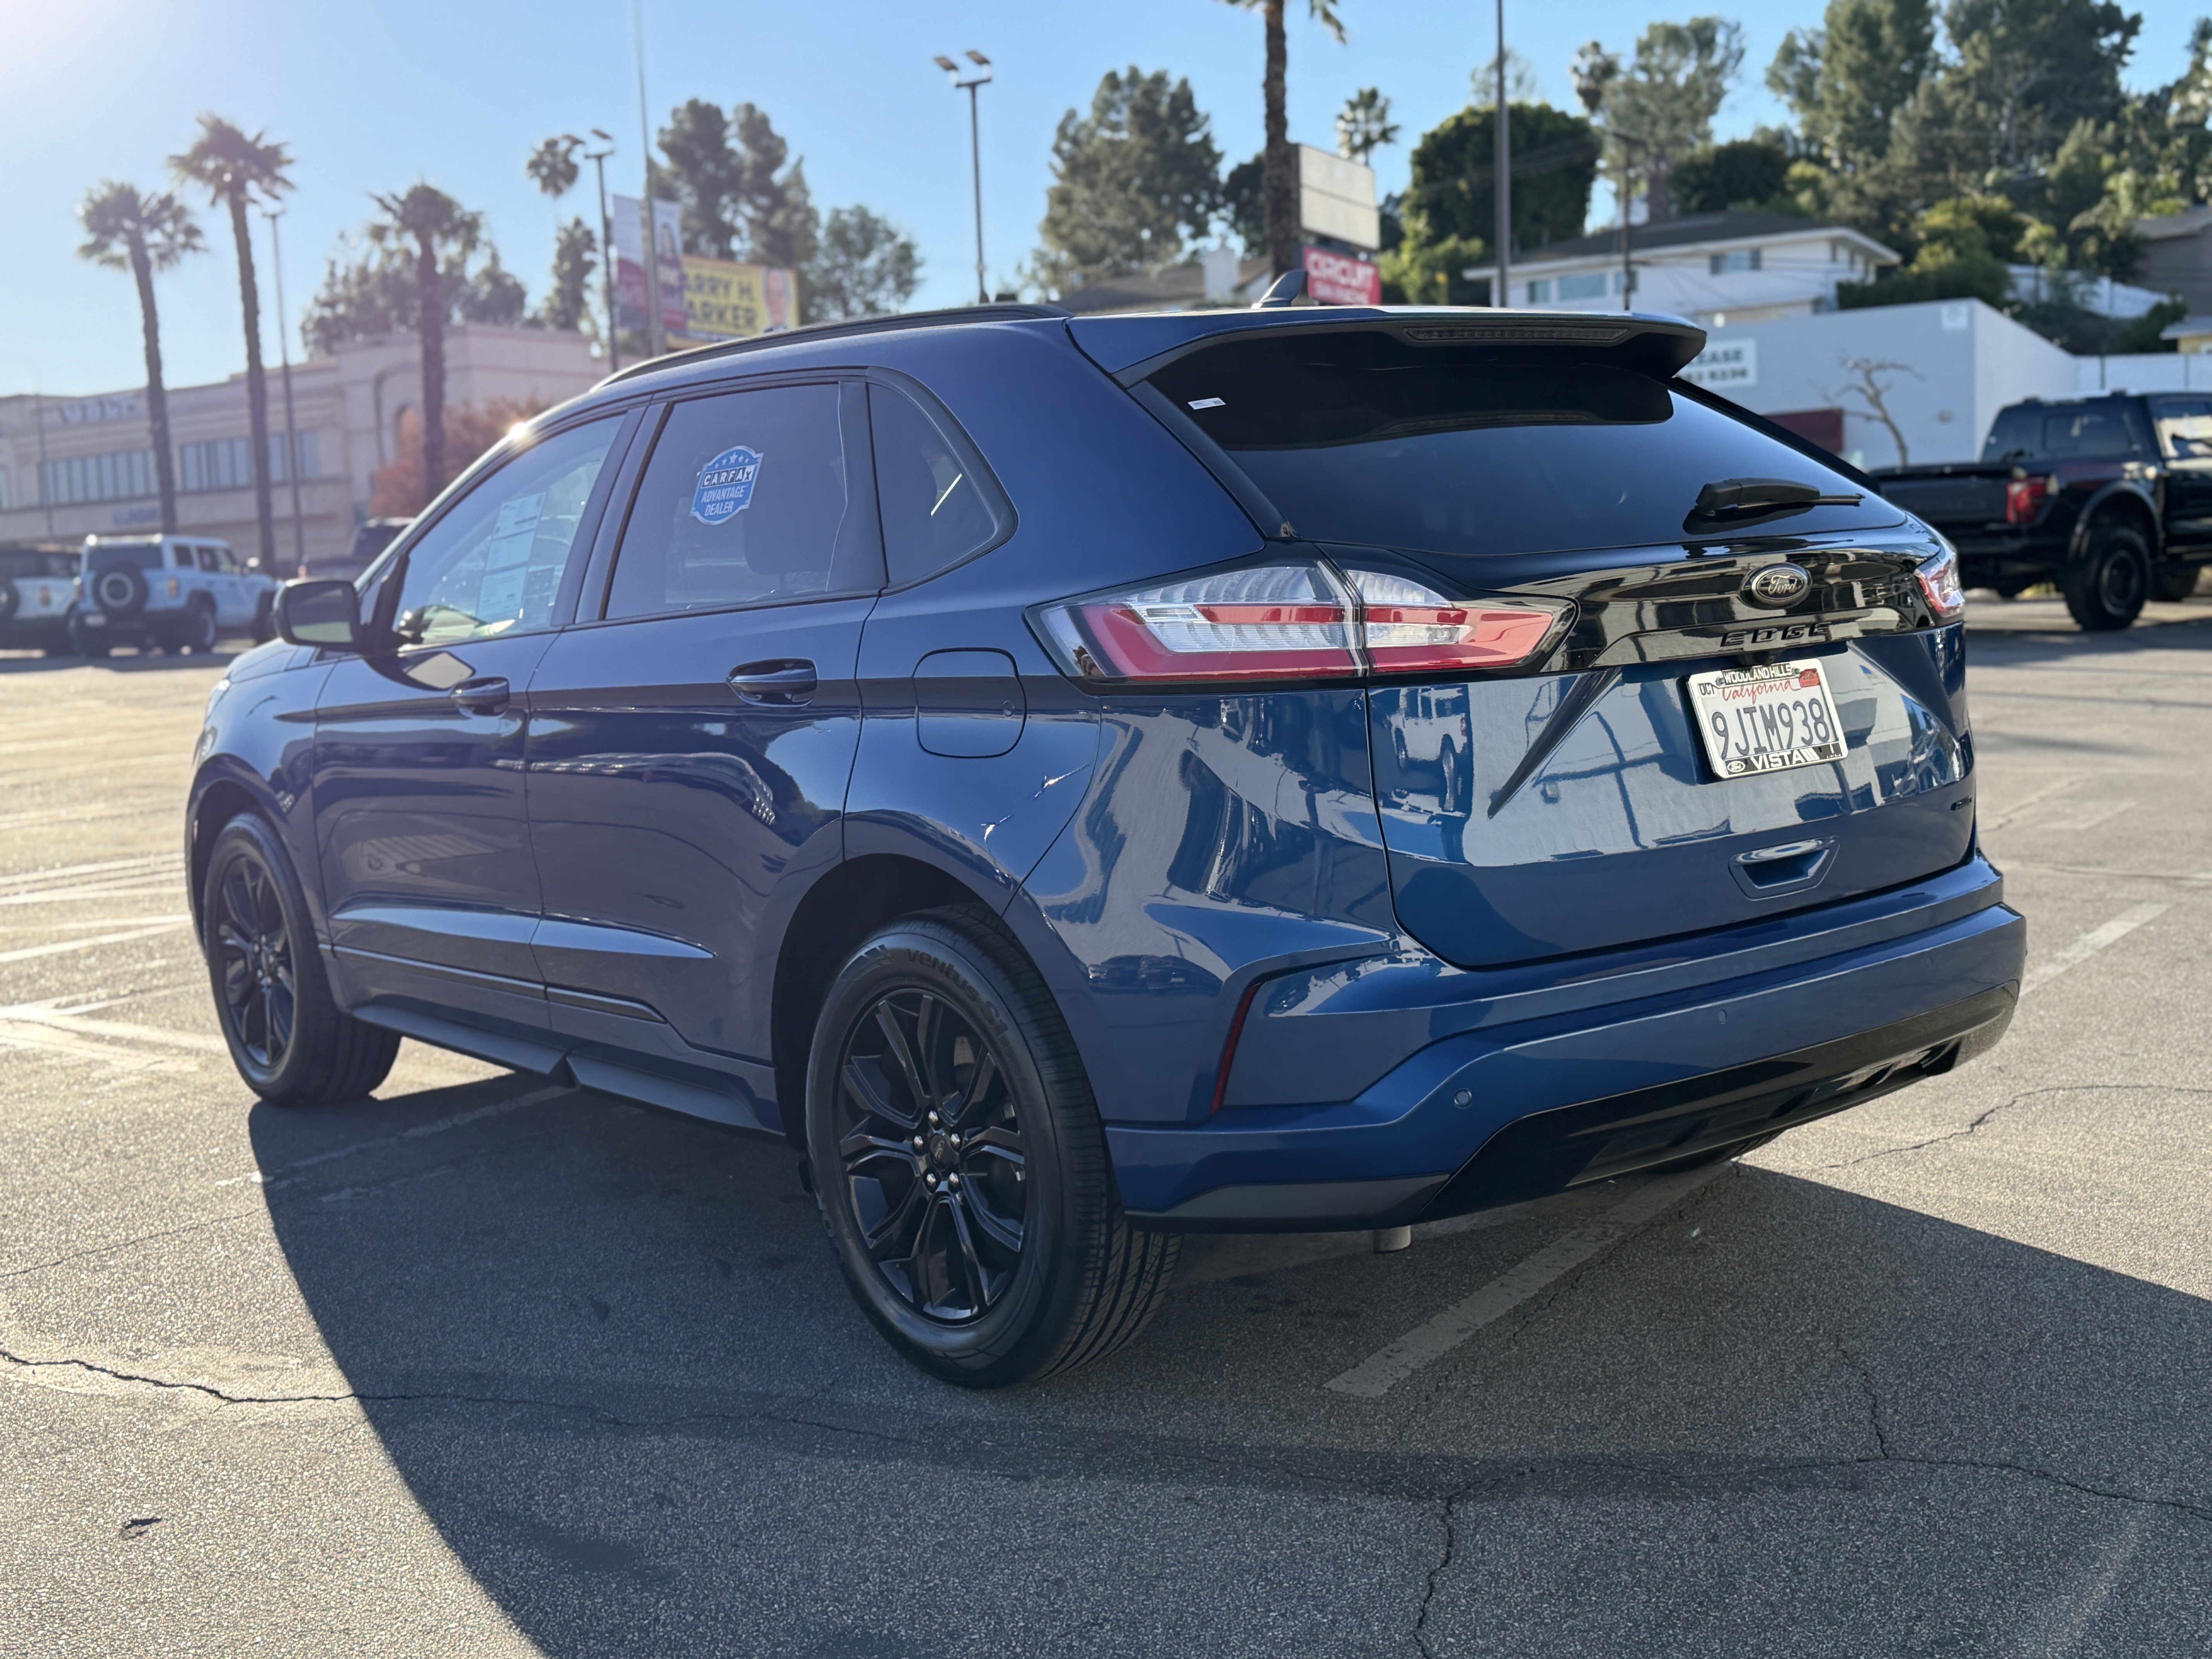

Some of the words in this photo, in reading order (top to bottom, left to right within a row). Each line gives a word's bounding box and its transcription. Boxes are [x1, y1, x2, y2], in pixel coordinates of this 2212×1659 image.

[1688, 349, 1742, 366] EASE
[703, 467, 754, 486] CARFAX
[701, 486, 745, 503] ADVANTAGE
[704, 501, 735, 517] DEALER
[1768, 574, 1800, 595] Ford
[1720, 622, 1832, 647] EDGE
[1723, 666, 1770, 684] WOODLAND
[1769, 664, 1792, 678] HILLS
[1722, 679, 1802, 705] California
[1711, 697, 1830, 759] 9JIM938
[1750, 749, 1805, 771] VISTA
